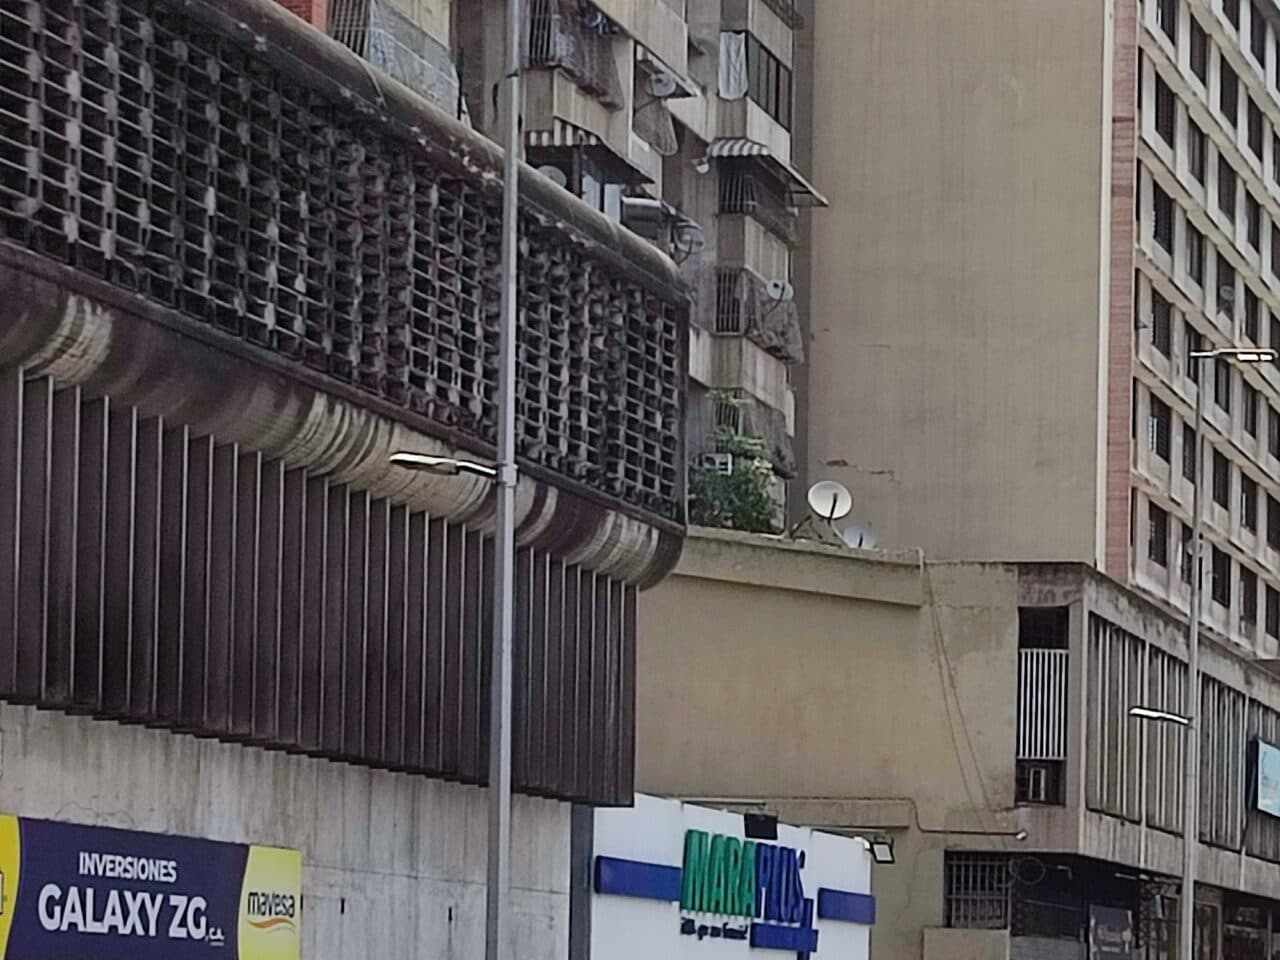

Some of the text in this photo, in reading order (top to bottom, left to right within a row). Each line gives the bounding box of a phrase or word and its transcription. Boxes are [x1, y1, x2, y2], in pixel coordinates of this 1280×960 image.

[78, 851, 177, 883] INVERSIONES
[38, 883, 163, 937] GALAXY
[248, 891, 296, 918] mavesa
